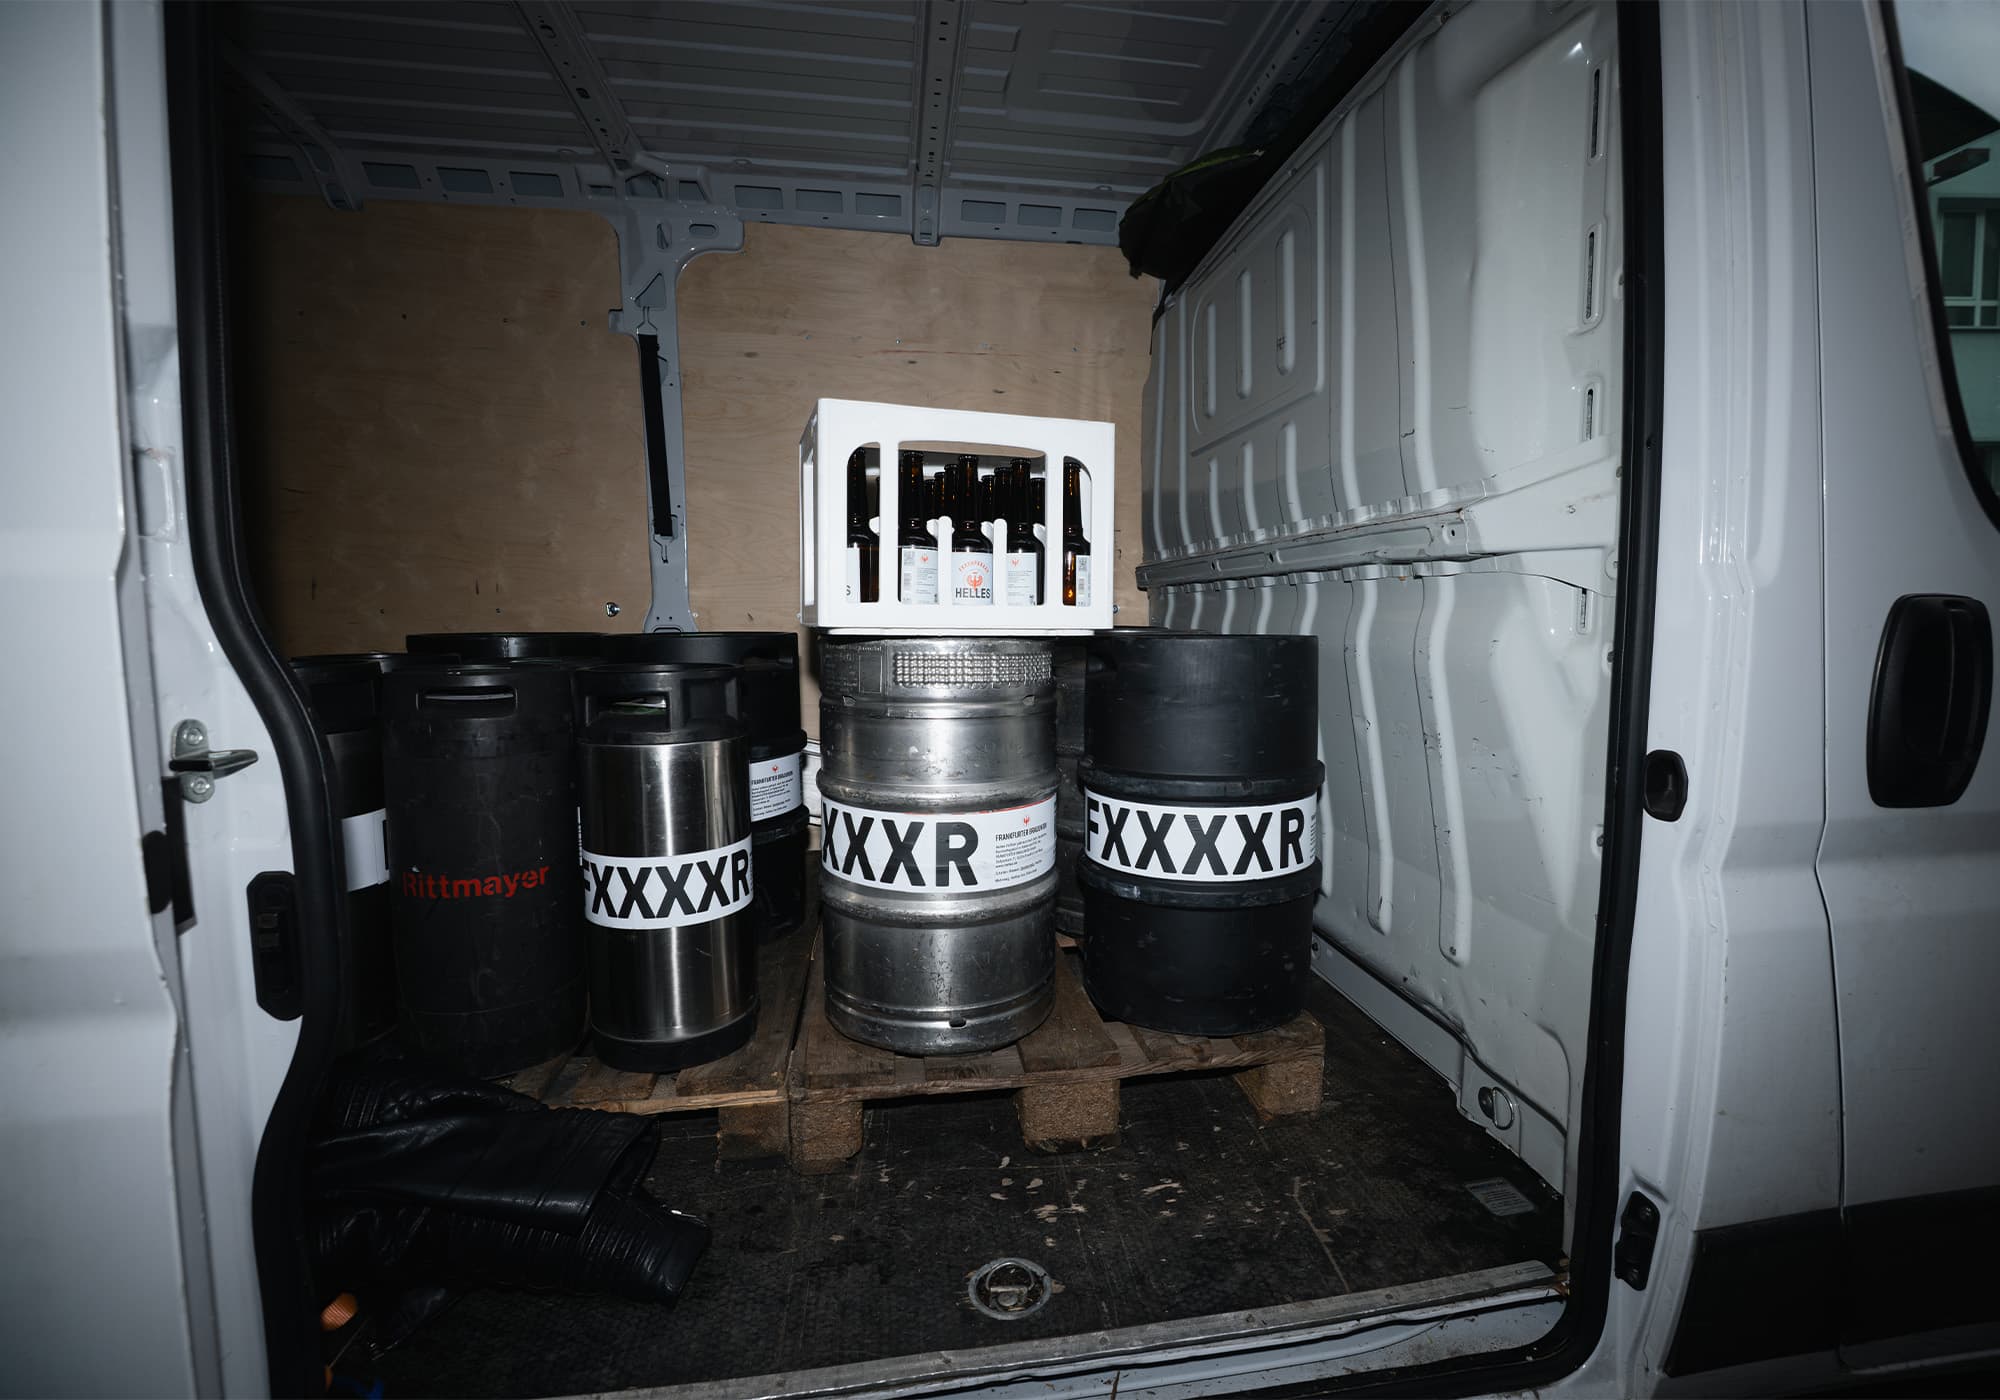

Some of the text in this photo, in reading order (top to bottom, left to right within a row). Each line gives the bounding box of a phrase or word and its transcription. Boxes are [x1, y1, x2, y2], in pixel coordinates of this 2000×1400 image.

[955, 587, 991, 599] HELLES
[995, 829, 1029, 841] FRANKFURTER
[1087, 796, 1305, 876] FXXXXR
[402, 865, 550, 900] Rittmayer
